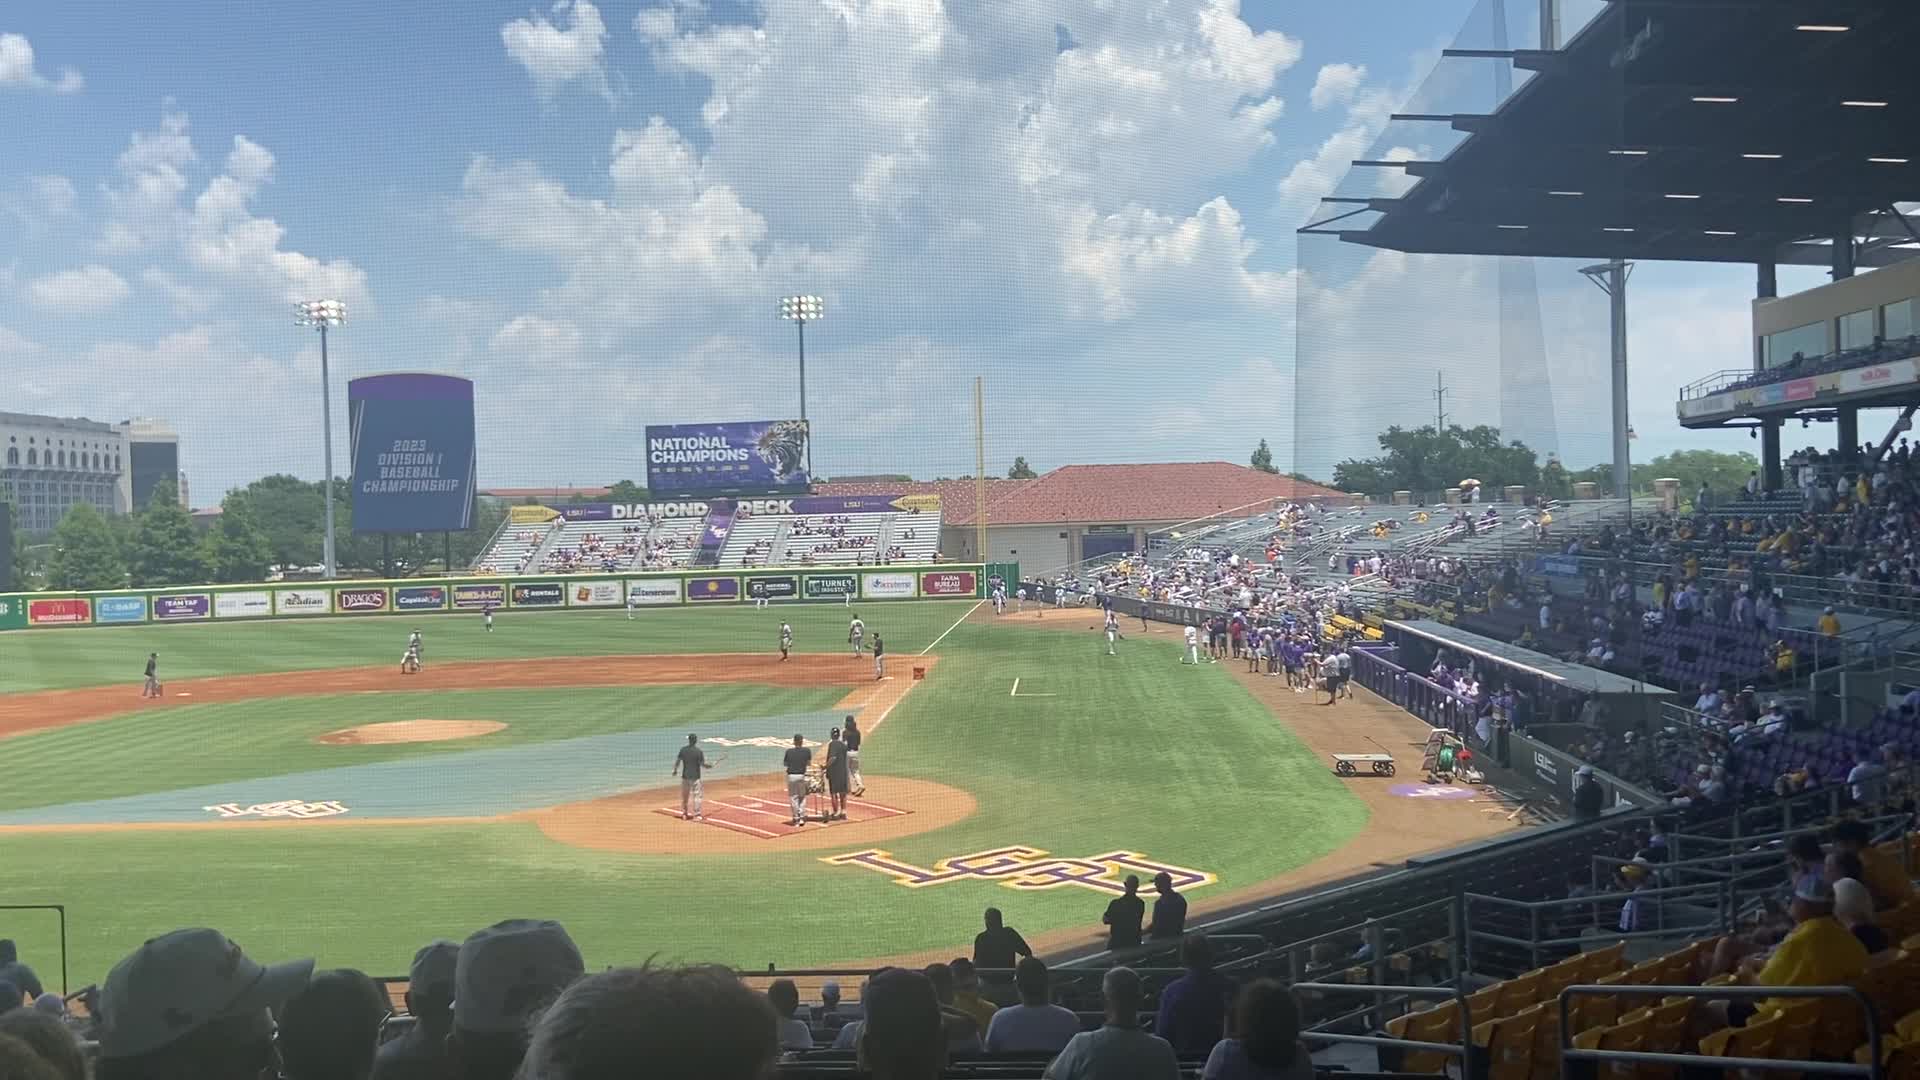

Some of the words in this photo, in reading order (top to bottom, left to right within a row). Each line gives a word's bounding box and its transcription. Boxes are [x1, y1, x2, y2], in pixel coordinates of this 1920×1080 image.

[393, 439, 427, 453] 2023
[650, 436, 731, 450] NATIONAL
[377, 452, 434, 466] DIVISION
[651, 448, 749, 464] CHAMPIONS
[380, 466, 441, 479] BASEBALL
[362, 479, 460, 493] CHAMPIONSHIP
[611, 502, 710, 519] DIAMOND
[737, 499, 795, 515] DECK
[821, 579, 852, 588] TURNER
[817, 845, 1218, 897] LSU
